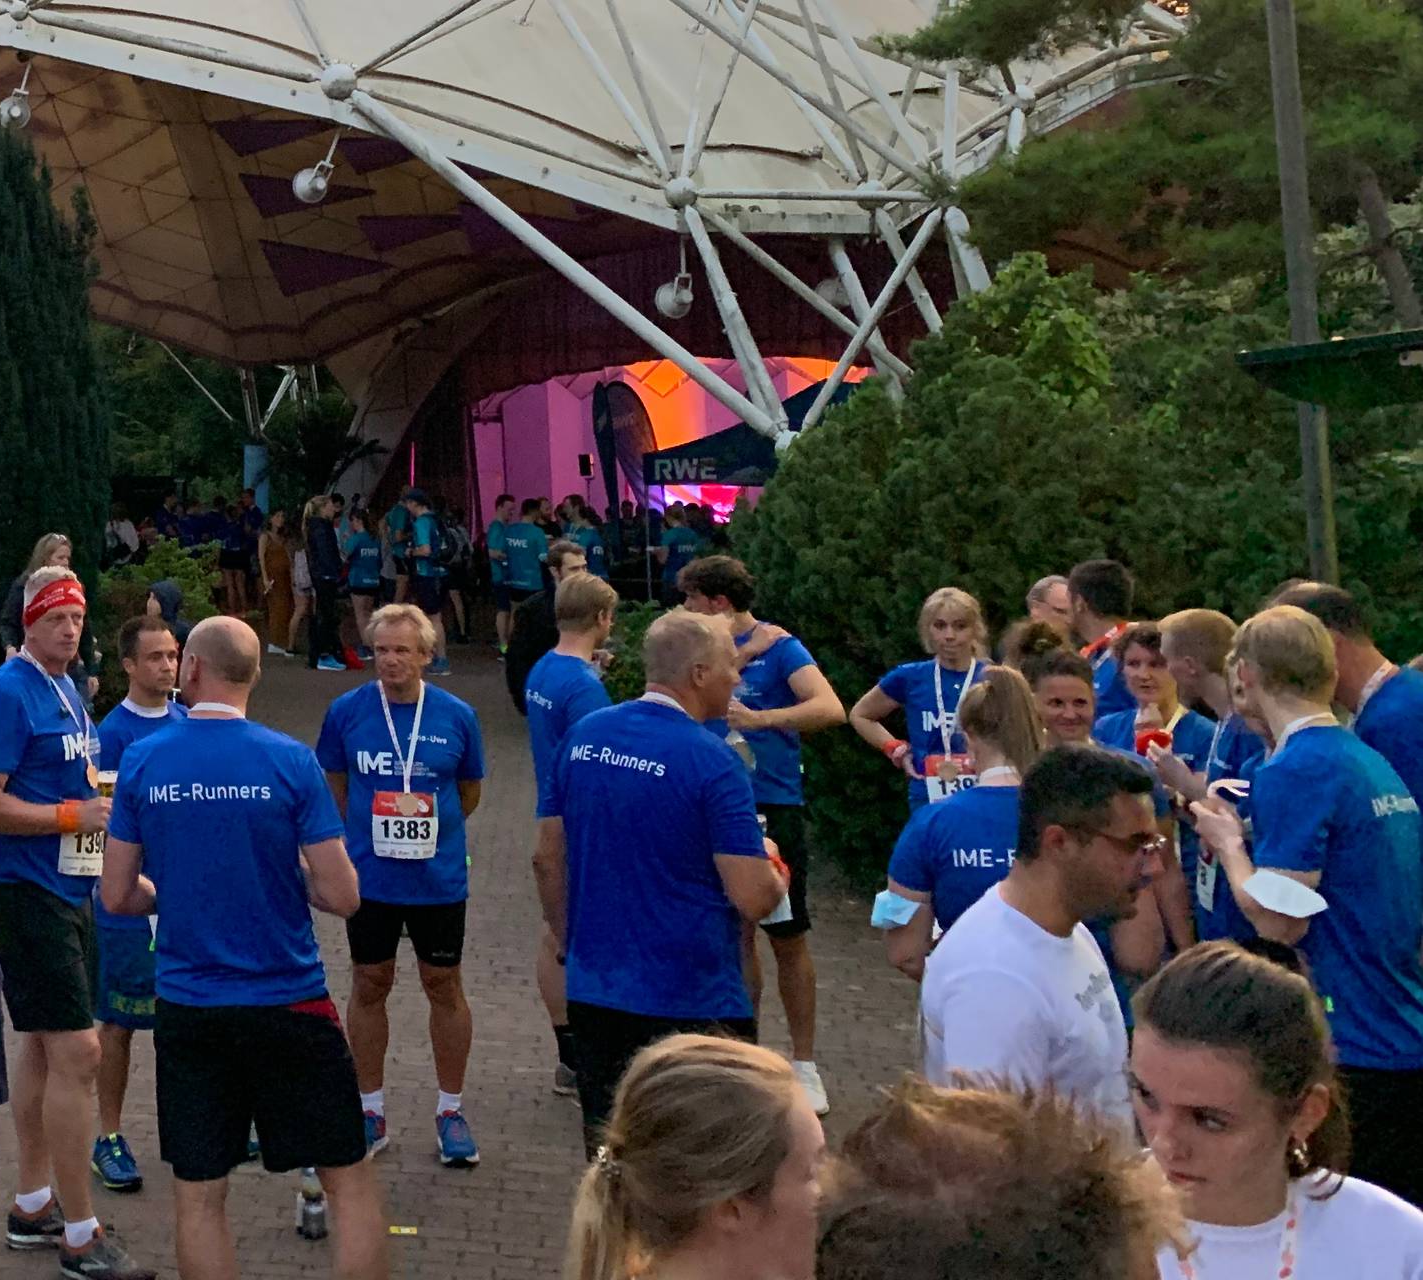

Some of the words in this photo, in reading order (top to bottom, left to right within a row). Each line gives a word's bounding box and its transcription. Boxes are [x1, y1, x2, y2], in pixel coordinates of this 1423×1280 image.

[654, 457, 718, 481] RWE
[357, 750, 393, 776] IME
[149, 783, 271, 804] IME-Runners
[381, 819, 431, 840] 1383
